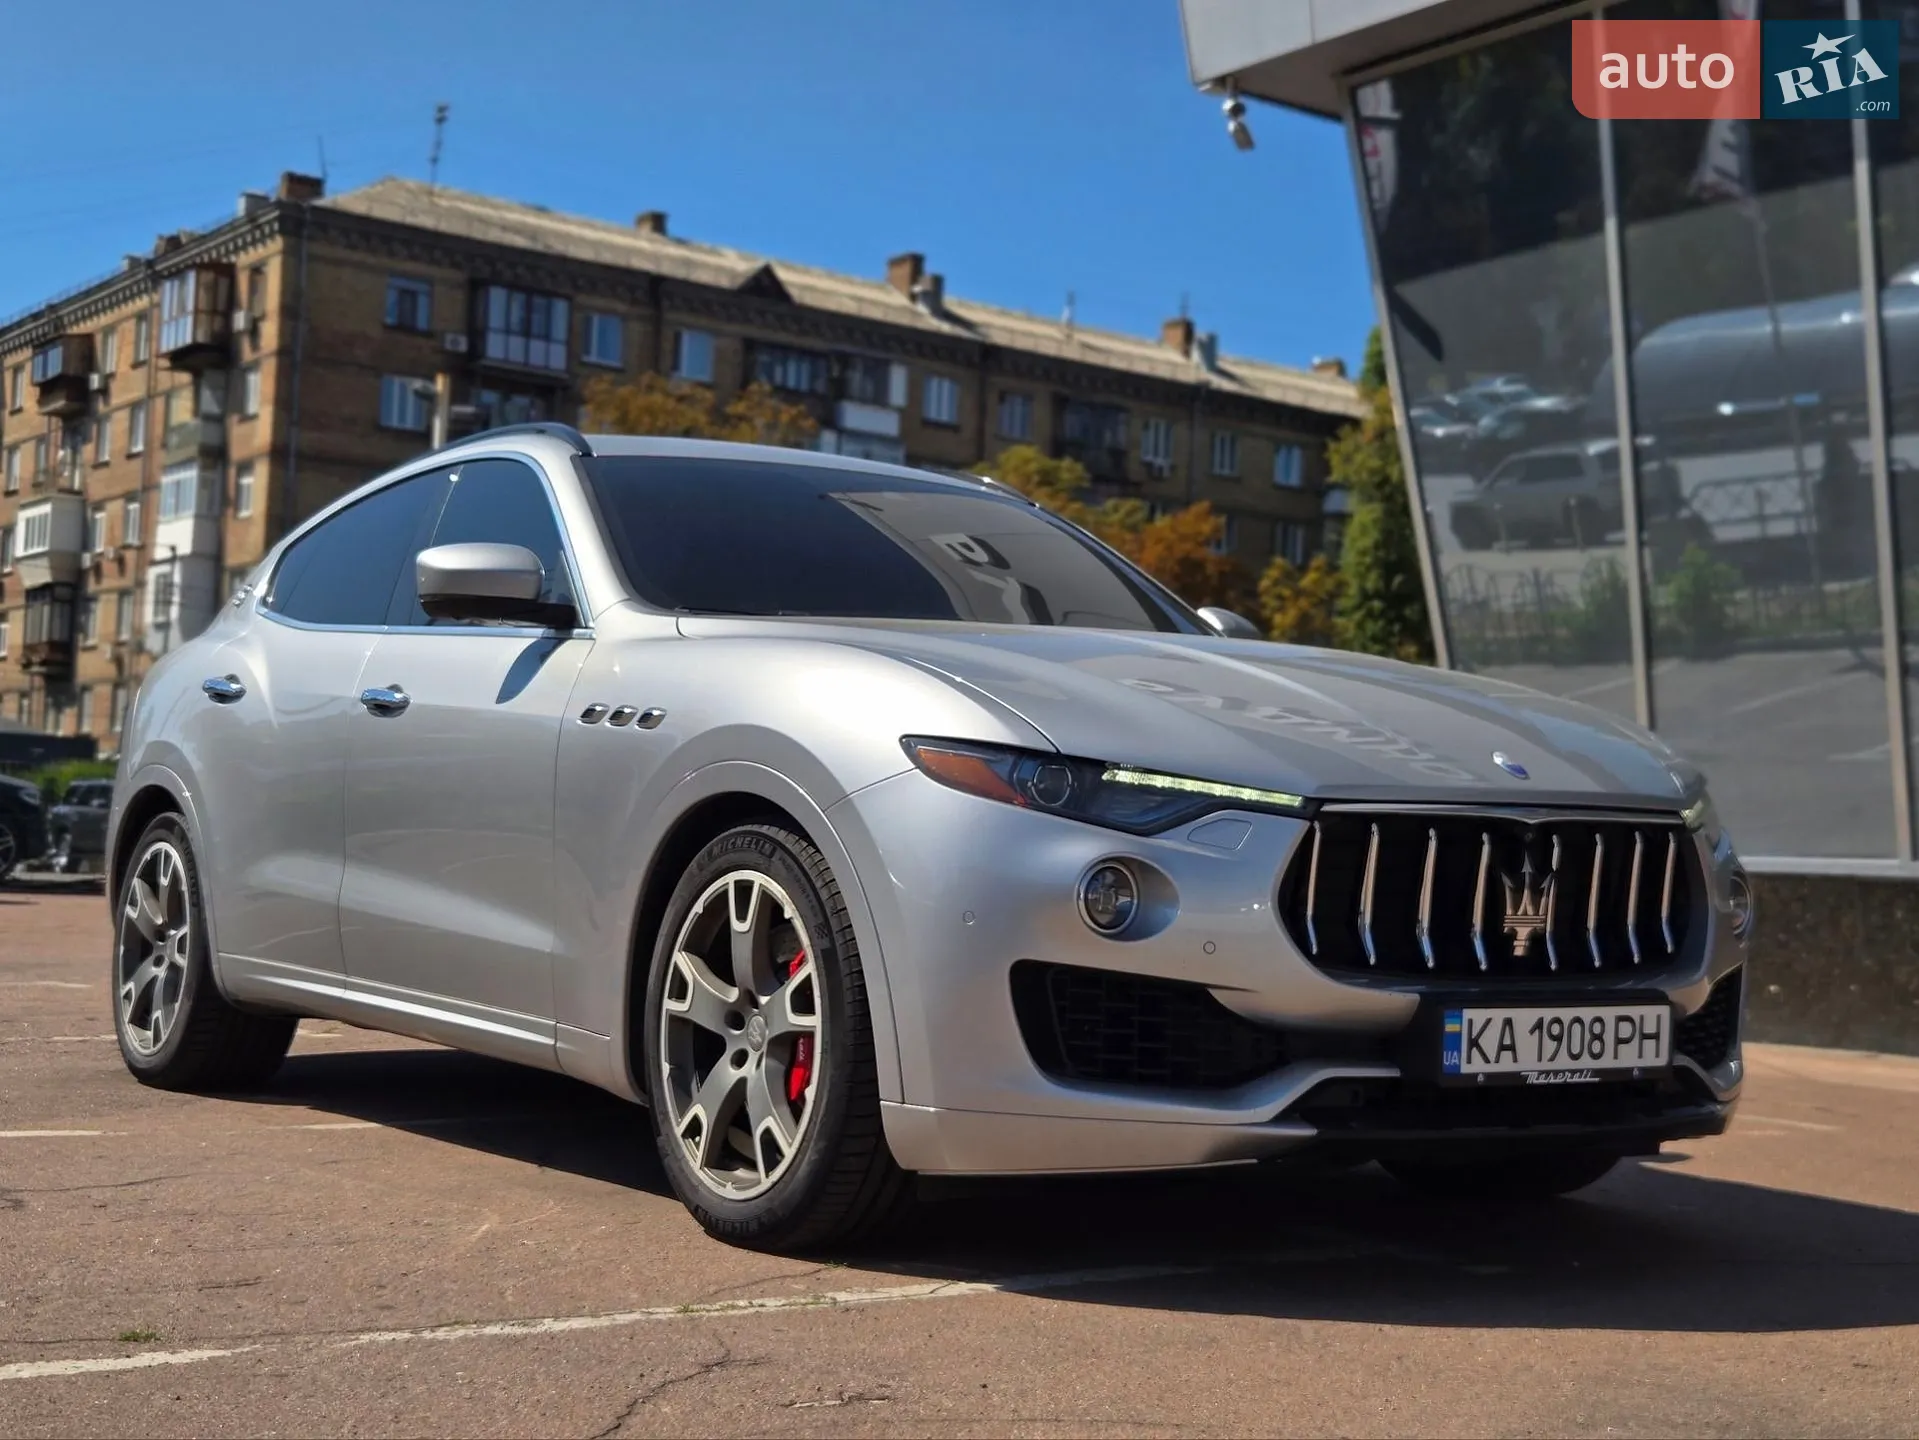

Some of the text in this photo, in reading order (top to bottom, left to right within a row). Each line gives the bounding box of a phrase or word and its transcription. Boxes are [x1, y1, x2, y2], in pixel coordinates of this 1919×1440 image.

[711, 836, 774, 857] MICHELIN
[1466, 1013, 1662, 1064] KA 1908 PH
[1443, 1051, 1459, 1066] UA
